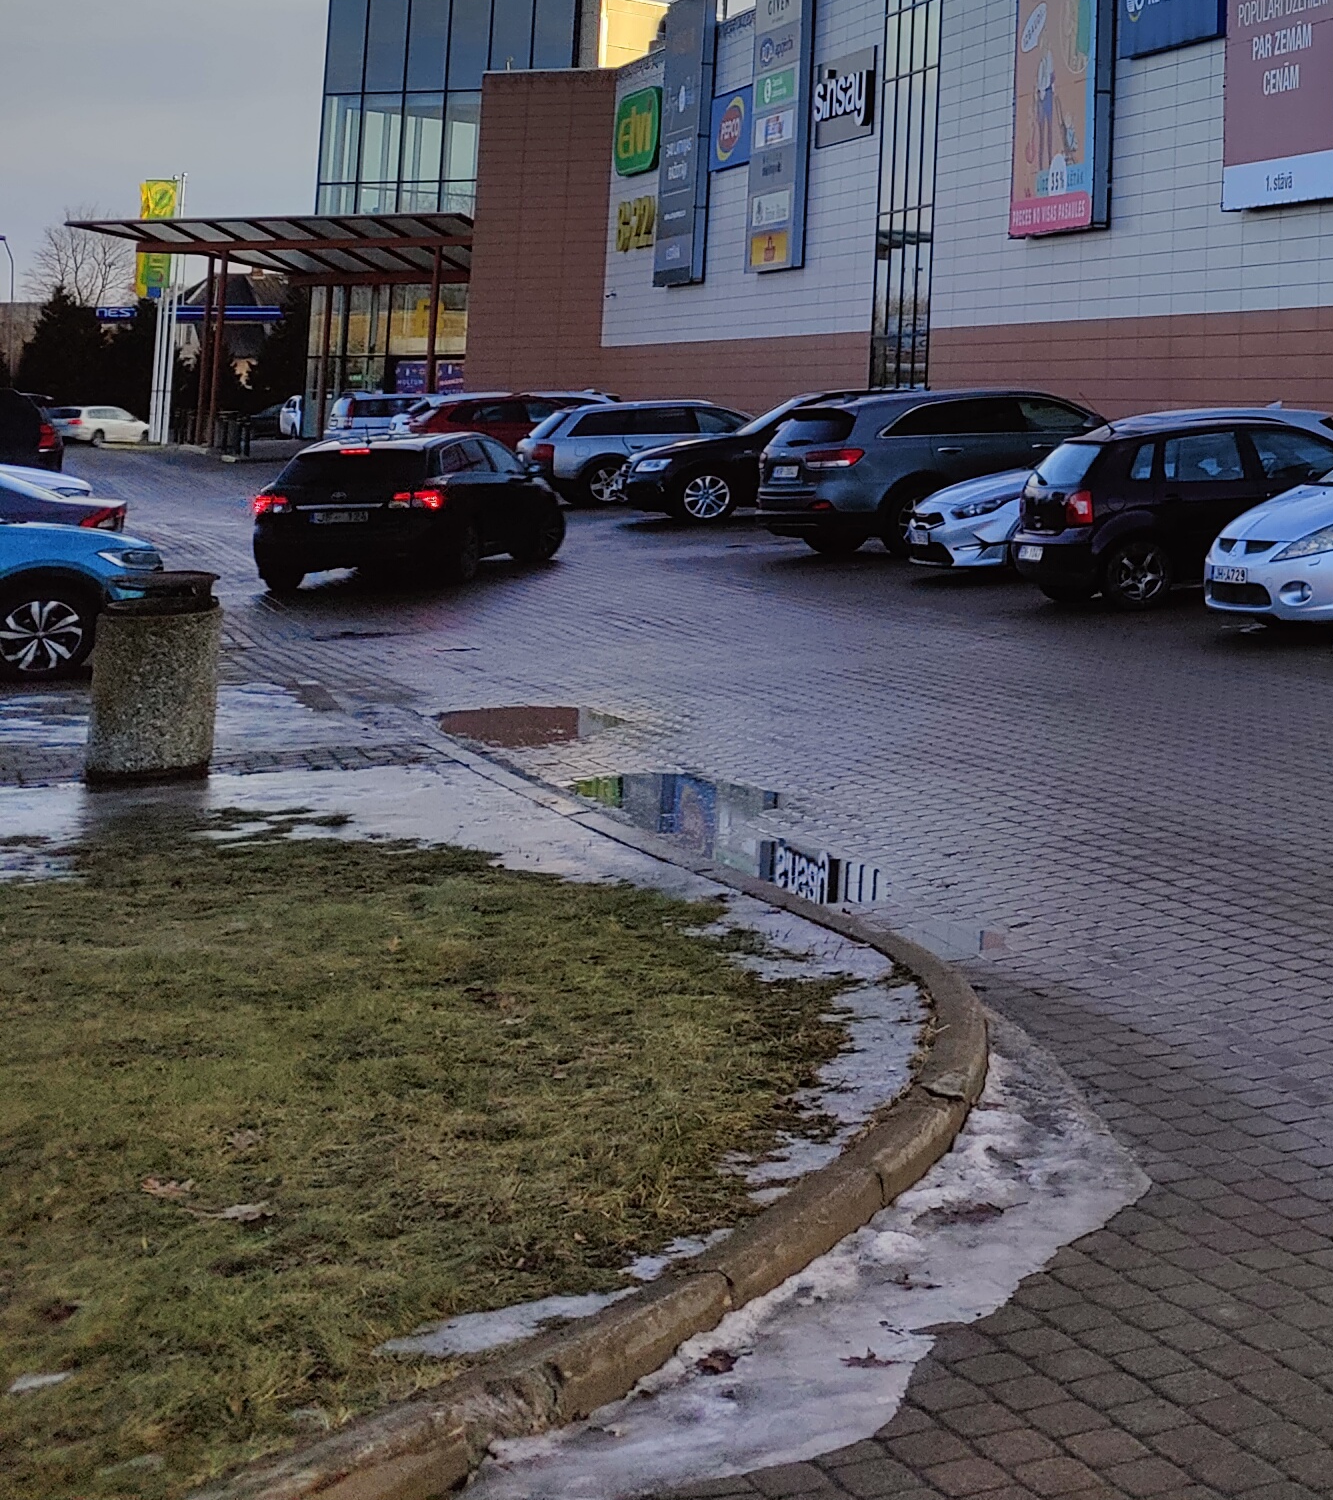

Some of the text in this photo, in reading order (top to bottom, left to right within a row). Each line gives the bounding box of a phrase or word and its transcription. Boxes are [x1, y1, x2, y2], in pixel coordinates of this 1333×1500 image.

[1252, 21, 1312, 60] PAR ZEMĀM
[1263, 62, 1300, 95] CENĀM
[814, 69, 868, 126] sinsay
[719, 117, 740, 141] PEPCO
[1273, 172, 1293, 190] stāvā
